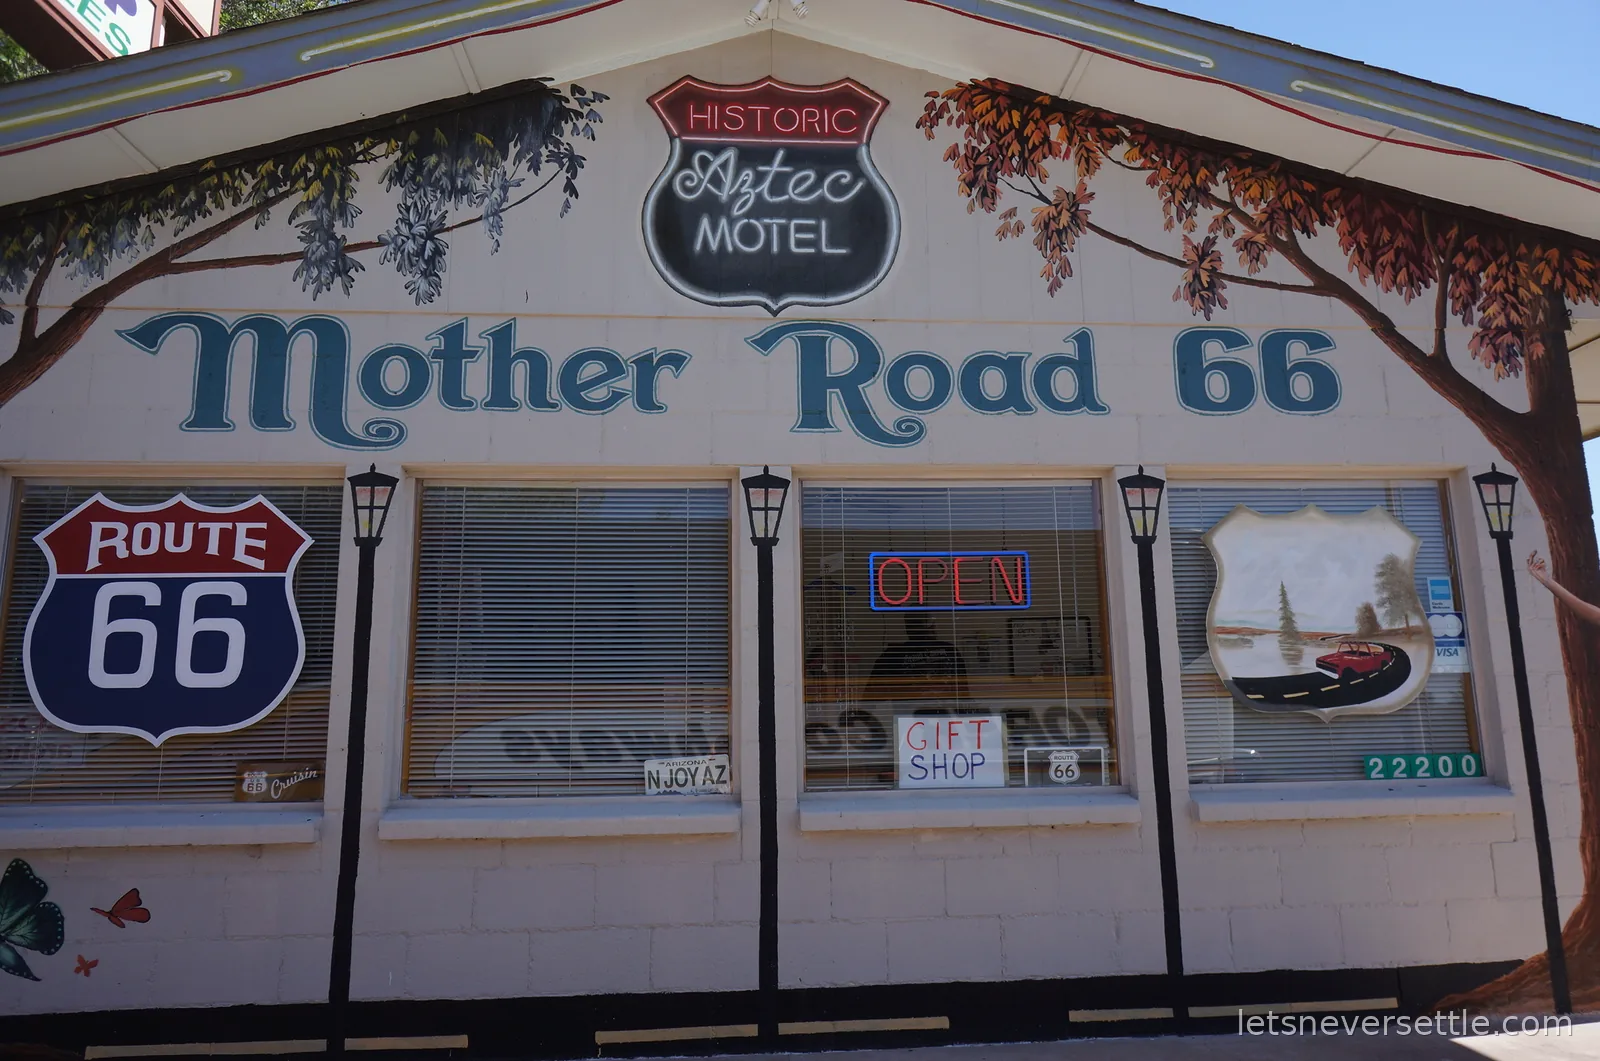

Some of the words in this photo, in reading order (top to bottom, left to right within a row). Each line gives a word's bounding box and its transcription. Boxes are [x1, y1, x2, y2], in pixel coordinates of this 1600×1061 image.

[689, 104, 858, 134] HISTORIC
[673, 147, 866, 216] Aztec
[694, 214, 847, 253] MOTEL
[114, 311, 693, 451] Mother
[743, 318, 1111, 448] Road
[1172, 326, 1343, 416] 66
[85, 521, 268, 572] ROUTE
[878, 557, 1023, 605] OPEN
[88, 581, 248, 689] 66
[1436, 648, 1459, 657] VISA
[906, 719, 989, 751] GIFT
[665, 759, 708, 767] ARIZONA
[908, 752, 985, 781] SHOP
[1054, 764, 1075, 779] 66
[1368, 754, 1477, 779] 22200
[247, 783, 263, 792] 66
[270, 767, 318, 800] Cruisin
